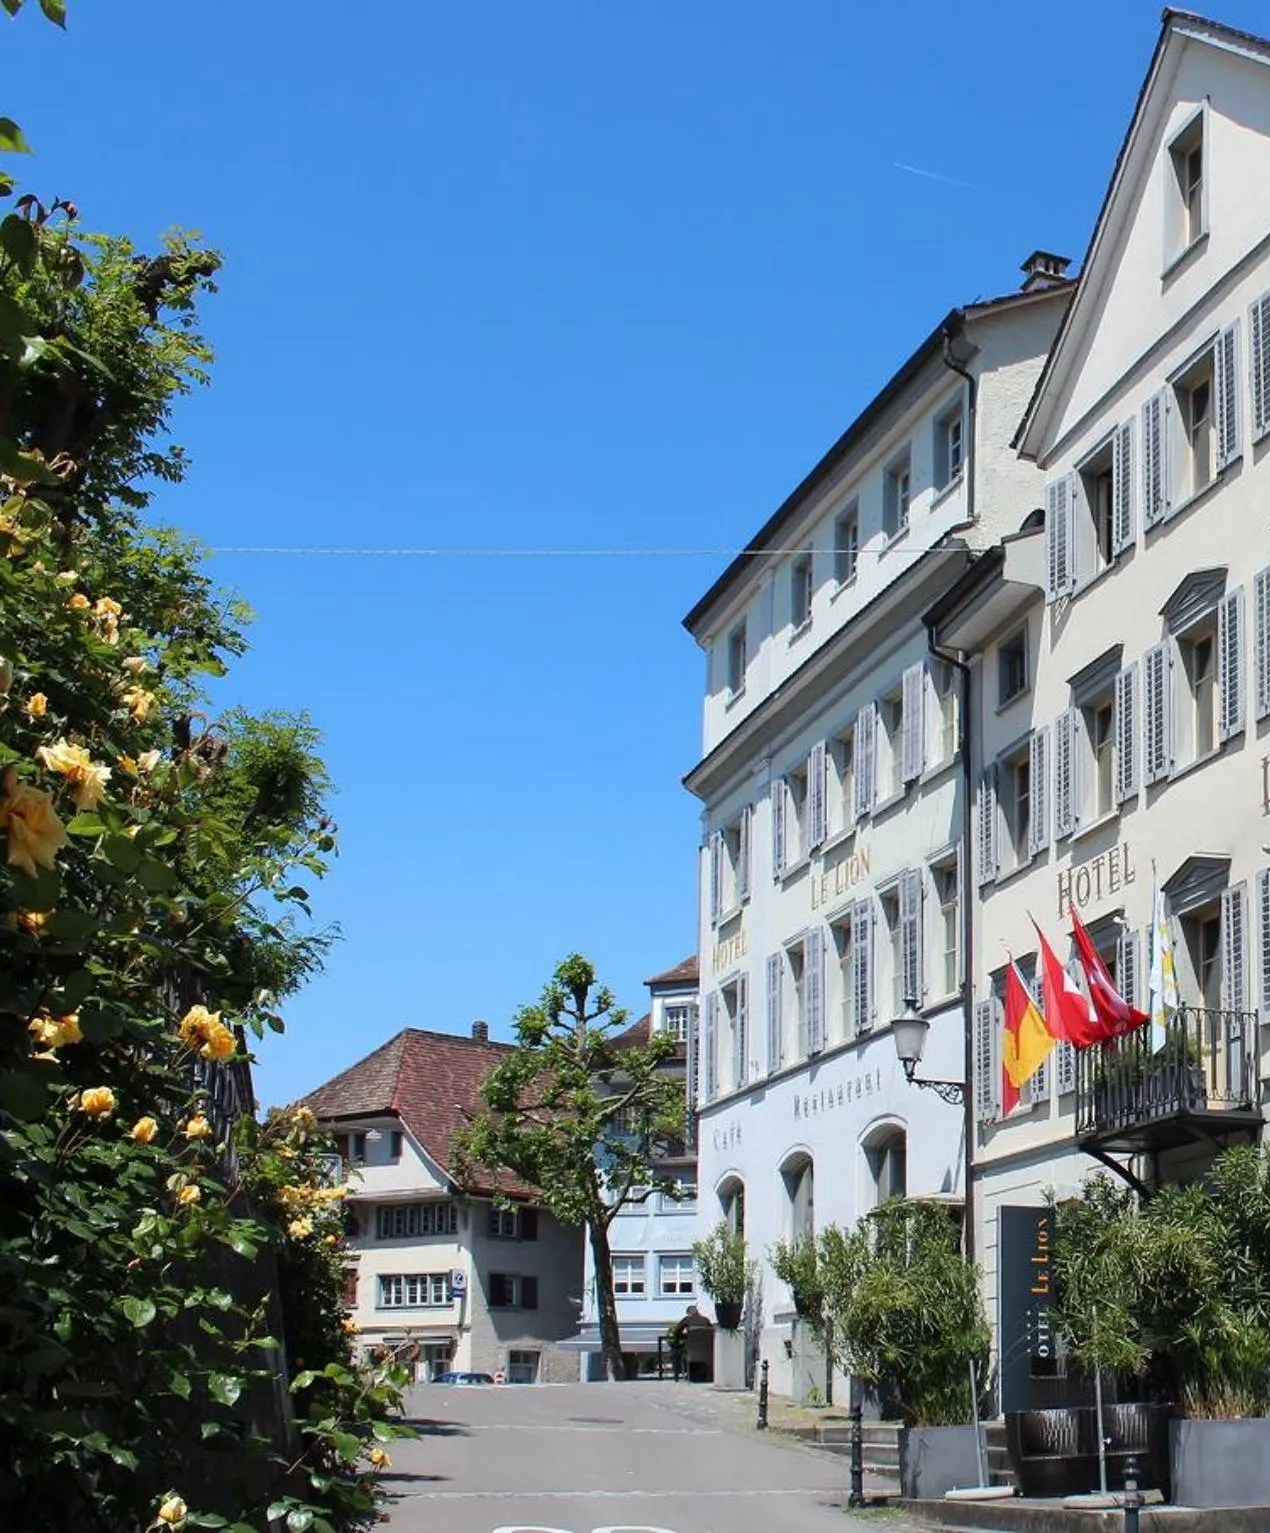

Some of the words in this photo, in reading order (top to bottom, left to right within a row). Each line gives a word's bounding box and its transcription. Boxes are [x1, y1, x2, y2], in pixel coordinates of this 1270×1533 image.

[810, 871, 828, 911] LE
[835, 846, 870, 896] LION
[1057, 842, 1136, 920] HOTEL
[1031, 1217, 1050, 1264] LION
[1031, 1270, 1050, 1295] LE
[1037, 1305, 1050, 1358] OTEL
